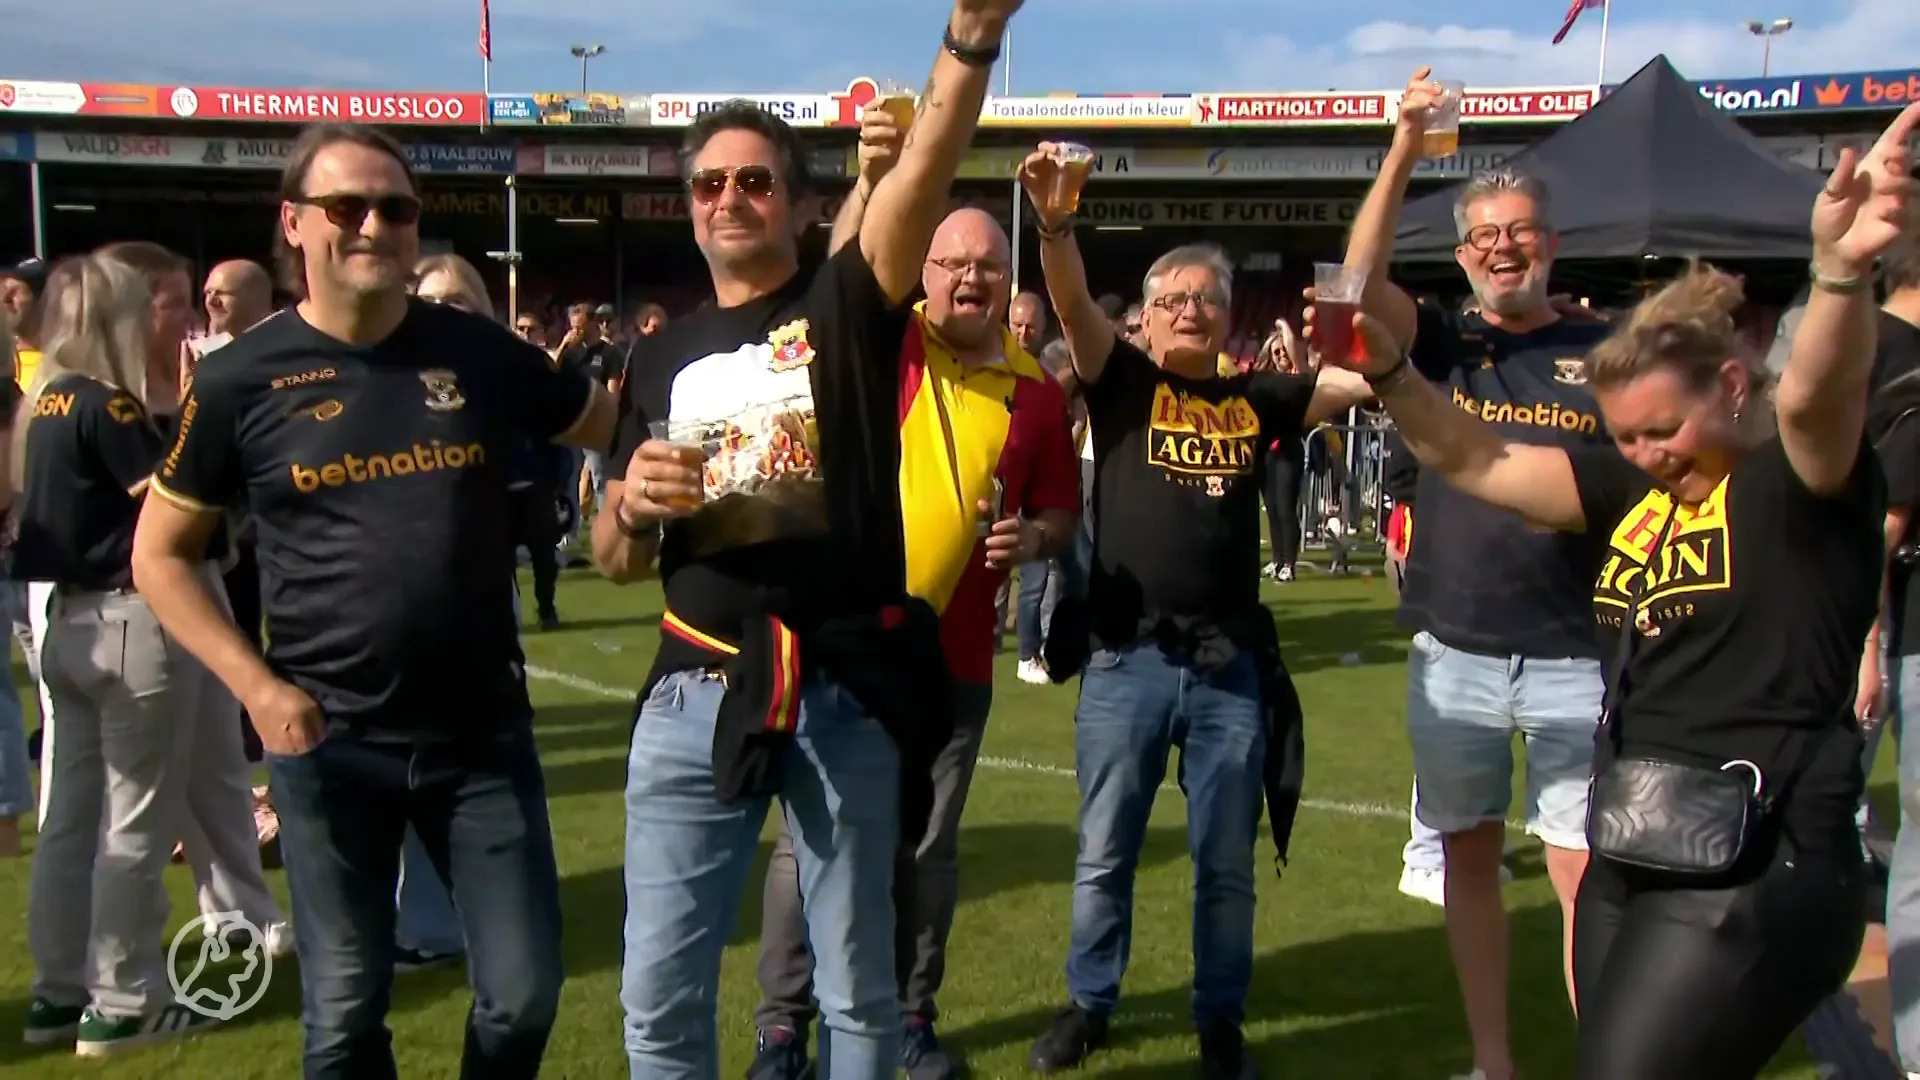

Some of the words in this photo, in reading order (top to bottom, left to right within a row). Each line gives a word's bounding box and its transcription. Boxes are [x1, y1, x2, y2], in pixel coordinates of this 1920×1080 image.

[217, 93, 339, 117] THERMEN
[350, 96, 464, 119] BUSSLOO
[992, 102, 1125, 117] Totaalonderhoud
[1129, 102, 1143, 117] in
[1148, 102, 1185, 117] kleur
[1223, 99, 1326, 116] HARTHOLT
[1332, 98, 1380, 115] OLIE
[1538, 94, 1589, 112] OLIE
[1076, 201, 1153, 222] ADING
[1163, 202, 1213, 222] THE
[1223, 202, 1329, 222] FUTURE
[1156, 435, 1257, 466] AGAIN
[290, 439, 486, 494] betnation
